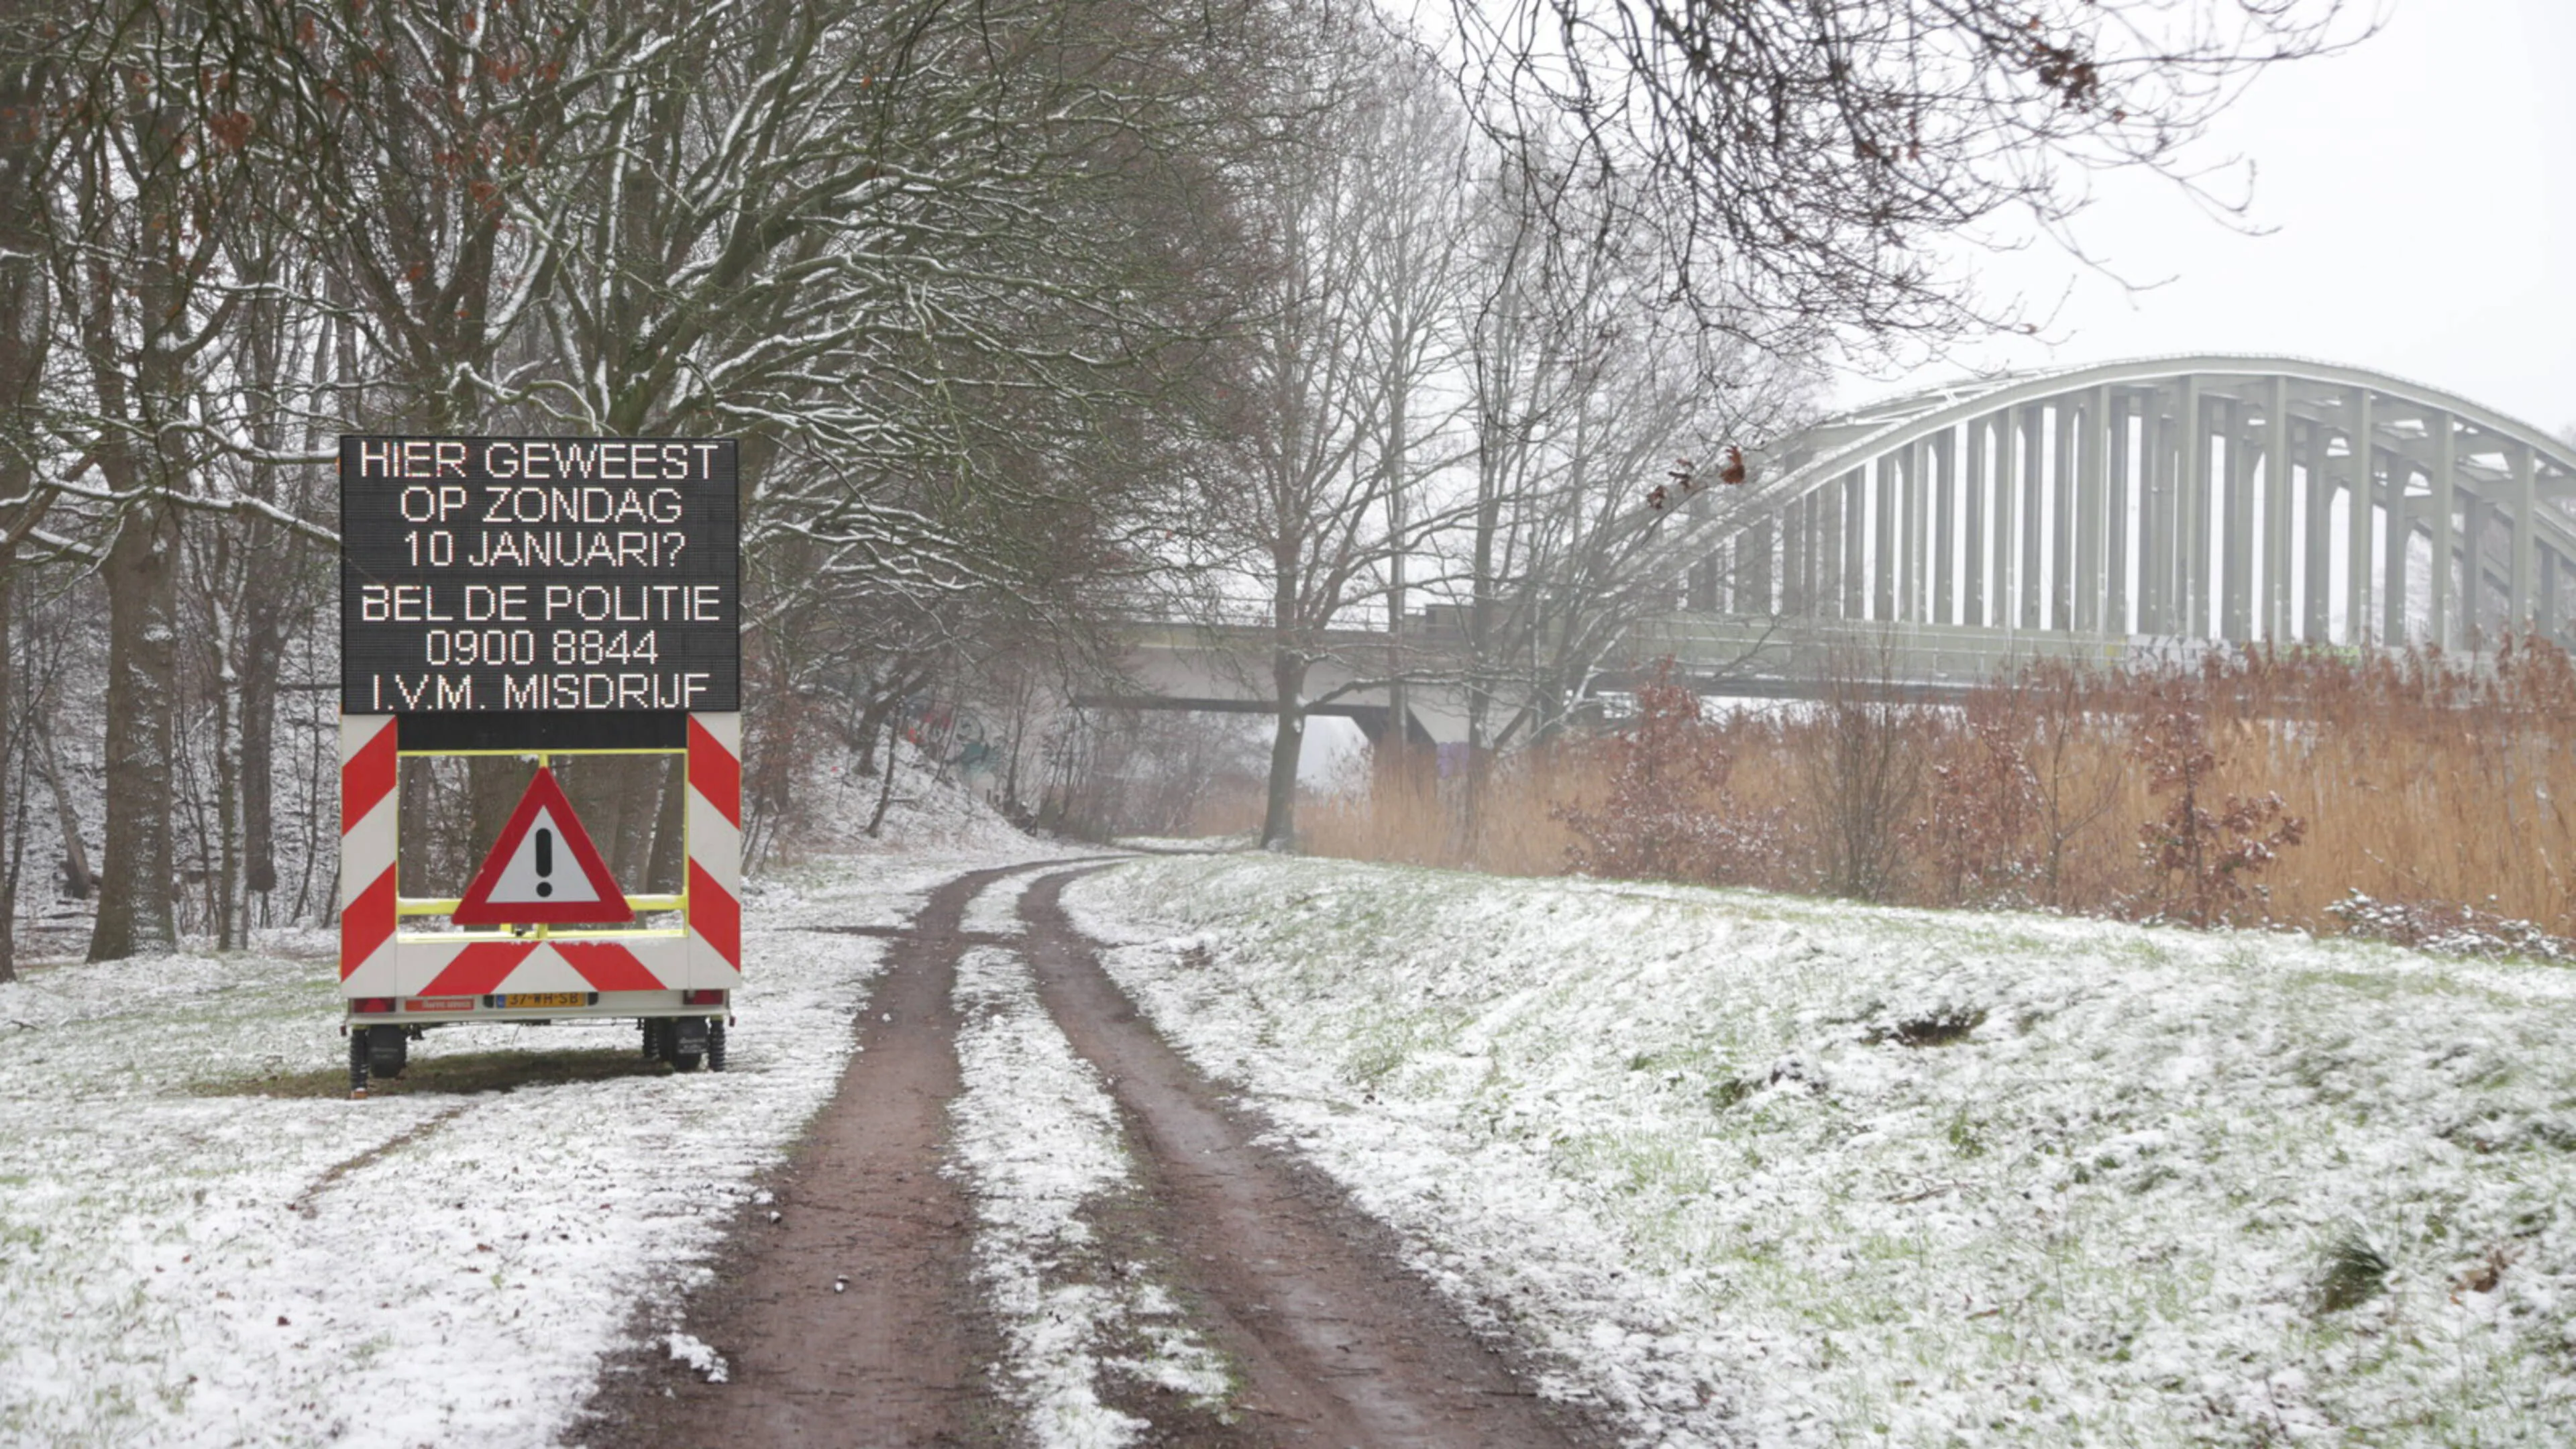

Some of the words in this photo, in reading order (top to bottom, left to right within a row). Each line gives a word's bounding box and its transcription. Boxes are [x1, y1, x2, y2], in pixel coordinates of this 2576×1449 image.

[360, 441, 467, 478] HIER
[485, 443, 719, 480] GEWEEST
[400, 486, 468, 523] OP
[482, 486, 682, 524] ZONDAG
[405, 531, 453, 568] 10
[468, 531, 686, 568] JANUARI?
[362, 585, 453, 622] BEL
[465, 586, 528, 622] DE
[545, 586, 720, 622] POLITIE
[426, 629, 535, 667] 0900
[553, 629, 659, 666] 8844
[373, 674, 486, 711] I.V.M.
[504, 674, 711, 710] MISDRIJF
